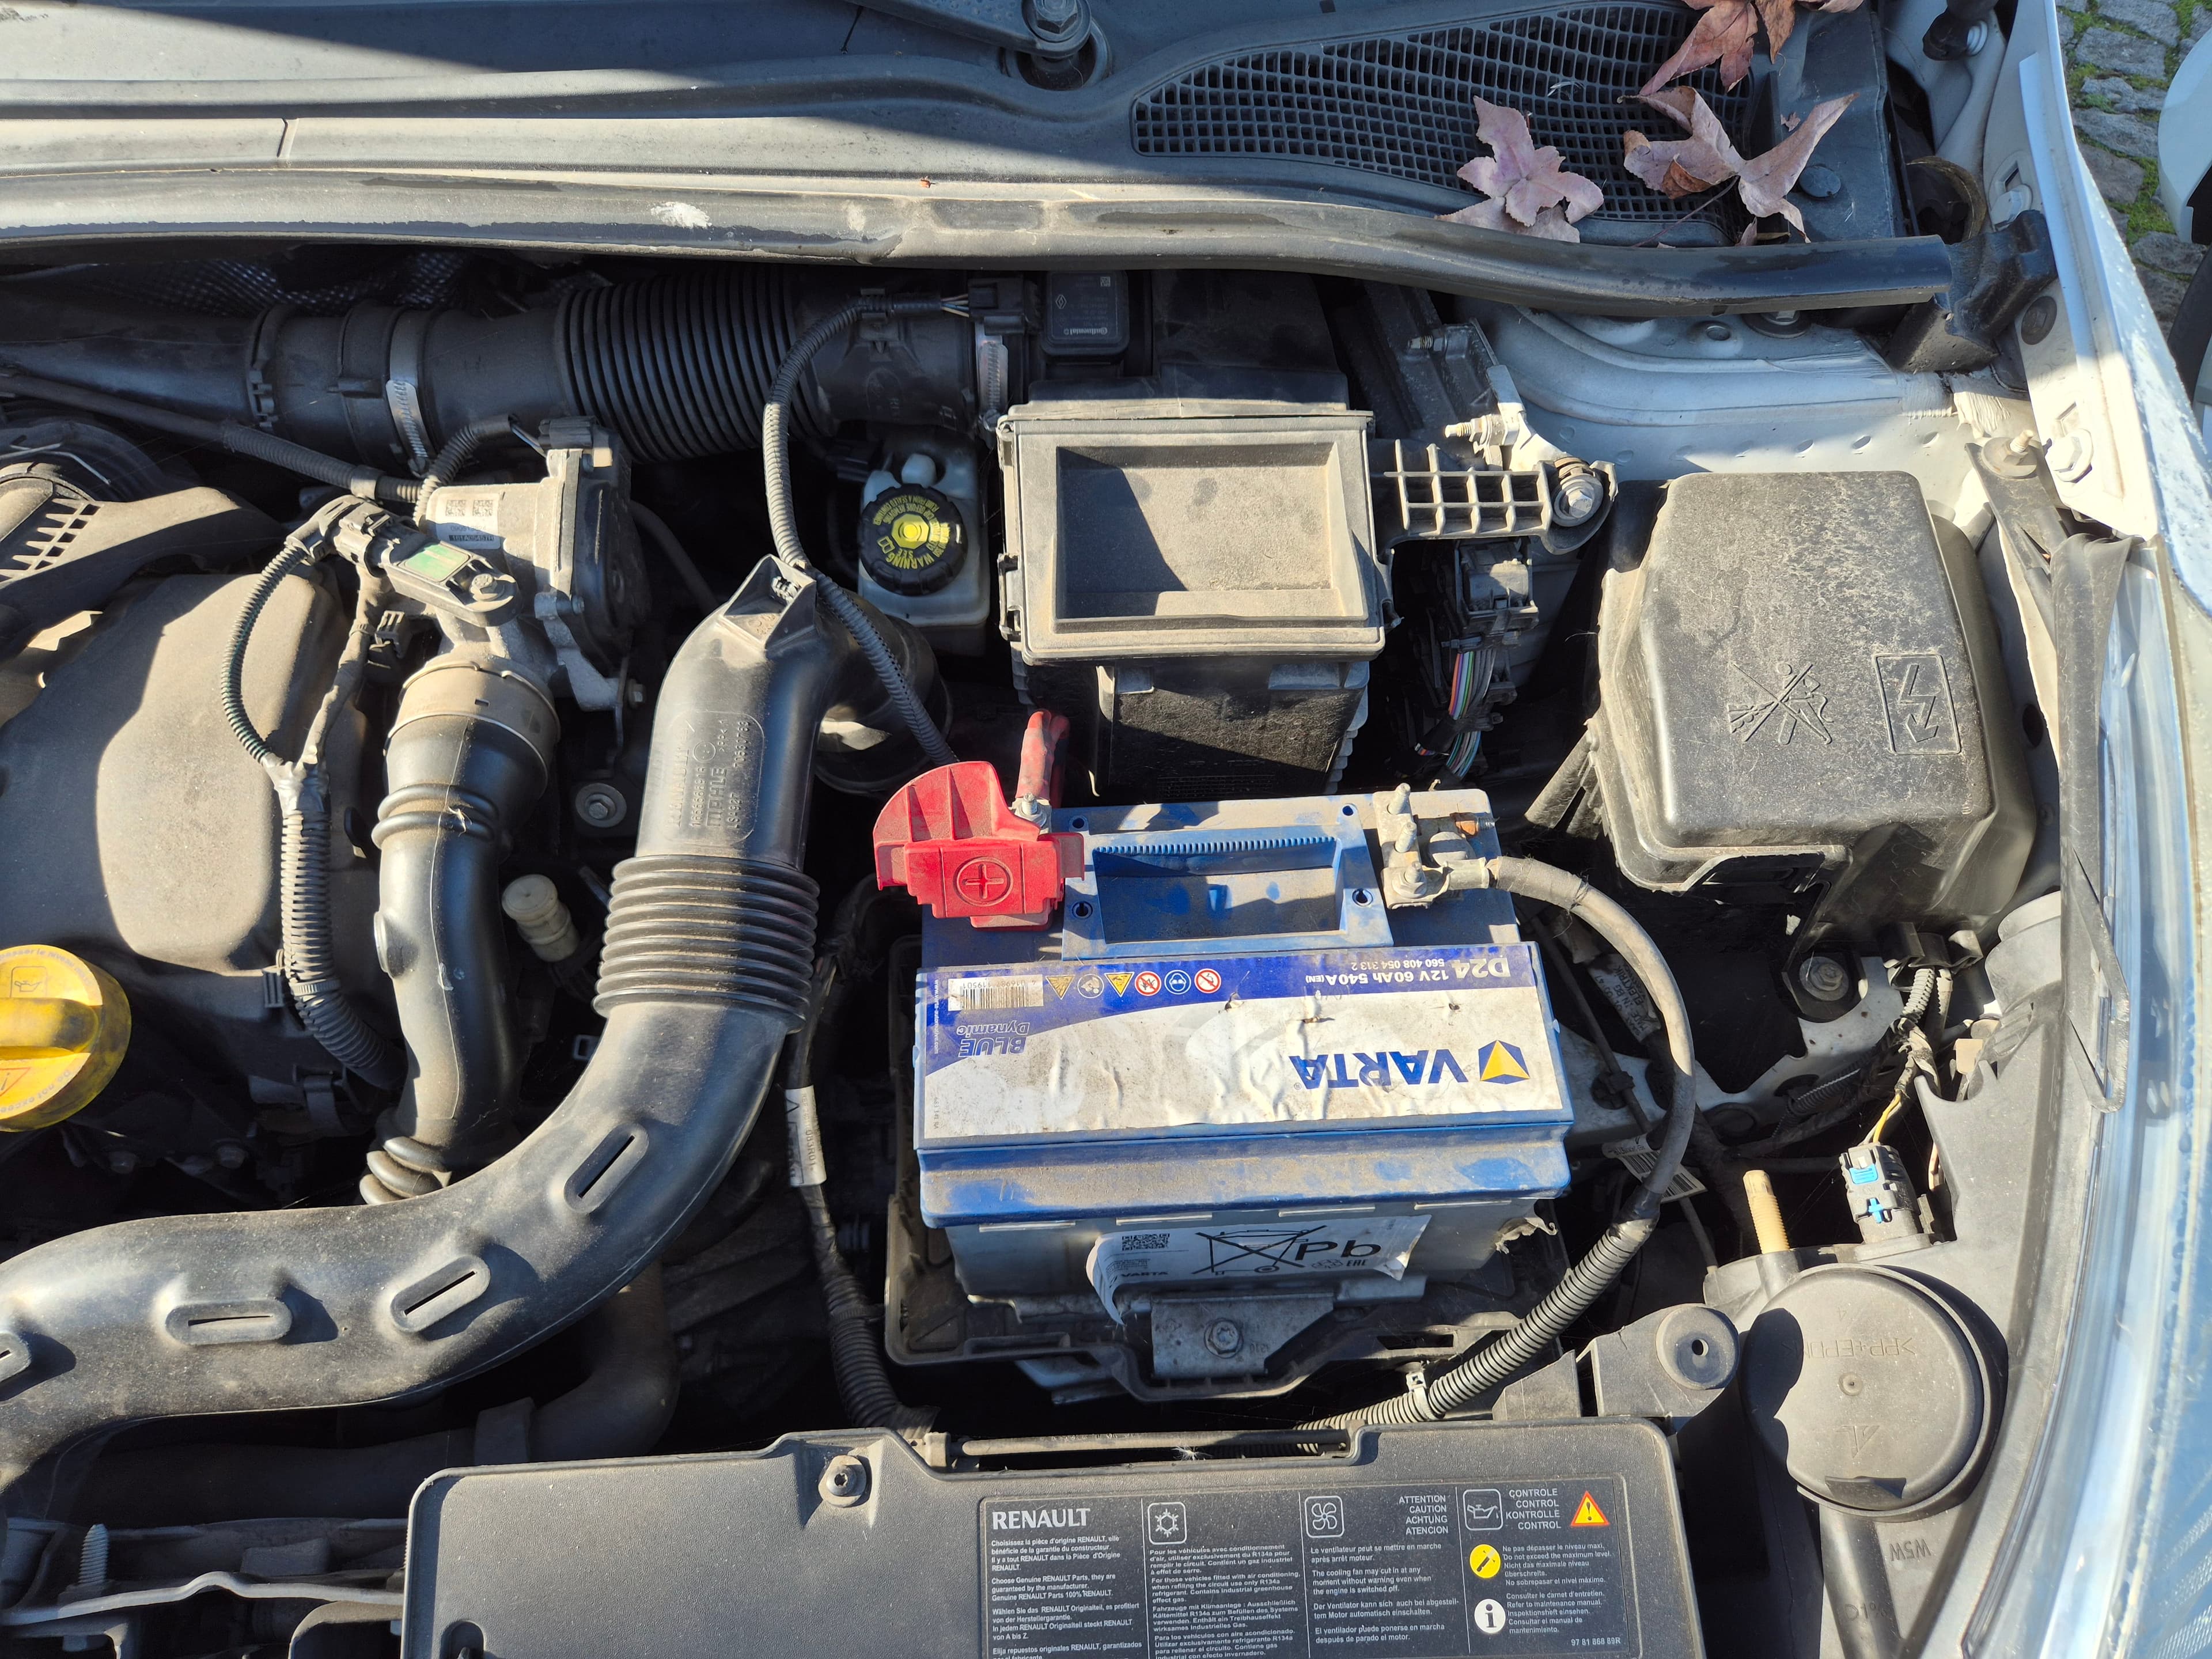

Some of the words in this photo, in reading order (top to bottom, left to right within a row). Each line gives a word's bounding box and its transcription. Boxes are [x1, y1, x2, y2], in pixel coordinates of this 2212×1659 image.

[897, 548, 914, 559] SEE
[885, 552, 935, 570] WARNING
[706, 767, 726, 827] MAHLE
[1351, 961, 1359, 971] 2
[1359, 960, 1379, 970] 313
[1381, 960, 1401, 969] 054
[1402, 959, 1423, 969] 408
[1425, 958, 1445, 968] 560
[1452, 957, 1510, 979] D24
[1418, 969, 1449, 981] 12V
[956, 1021, 1031, 1037] Dynamic
[958, 1036, 1028, 1058] BLUE
[1289, 1048, 1469, 1090] VARTA
[1294, 1239, 1382, 1261] Pb
[1509, 1488, 1558, 1497] CONTROLE
[1399, 1495, 1446, 1505] ATTENTION
[1516, 1499, 1559, 1508] CONTROL
[1409, 1505, 1447, 1514] CAUTION
[992, 1508, 1091, 1530] RENAULT
[1406, 1515, 1448, 1524] ACHTUNG
[1506, 1510, 1560, 1520] KONTROLLE
[1406, 1526, 1449, 1535] ATENCION
[1518, 1521, 1562, 1530] CONTROL
[1889, 1539, 1932, 1562] W5W
